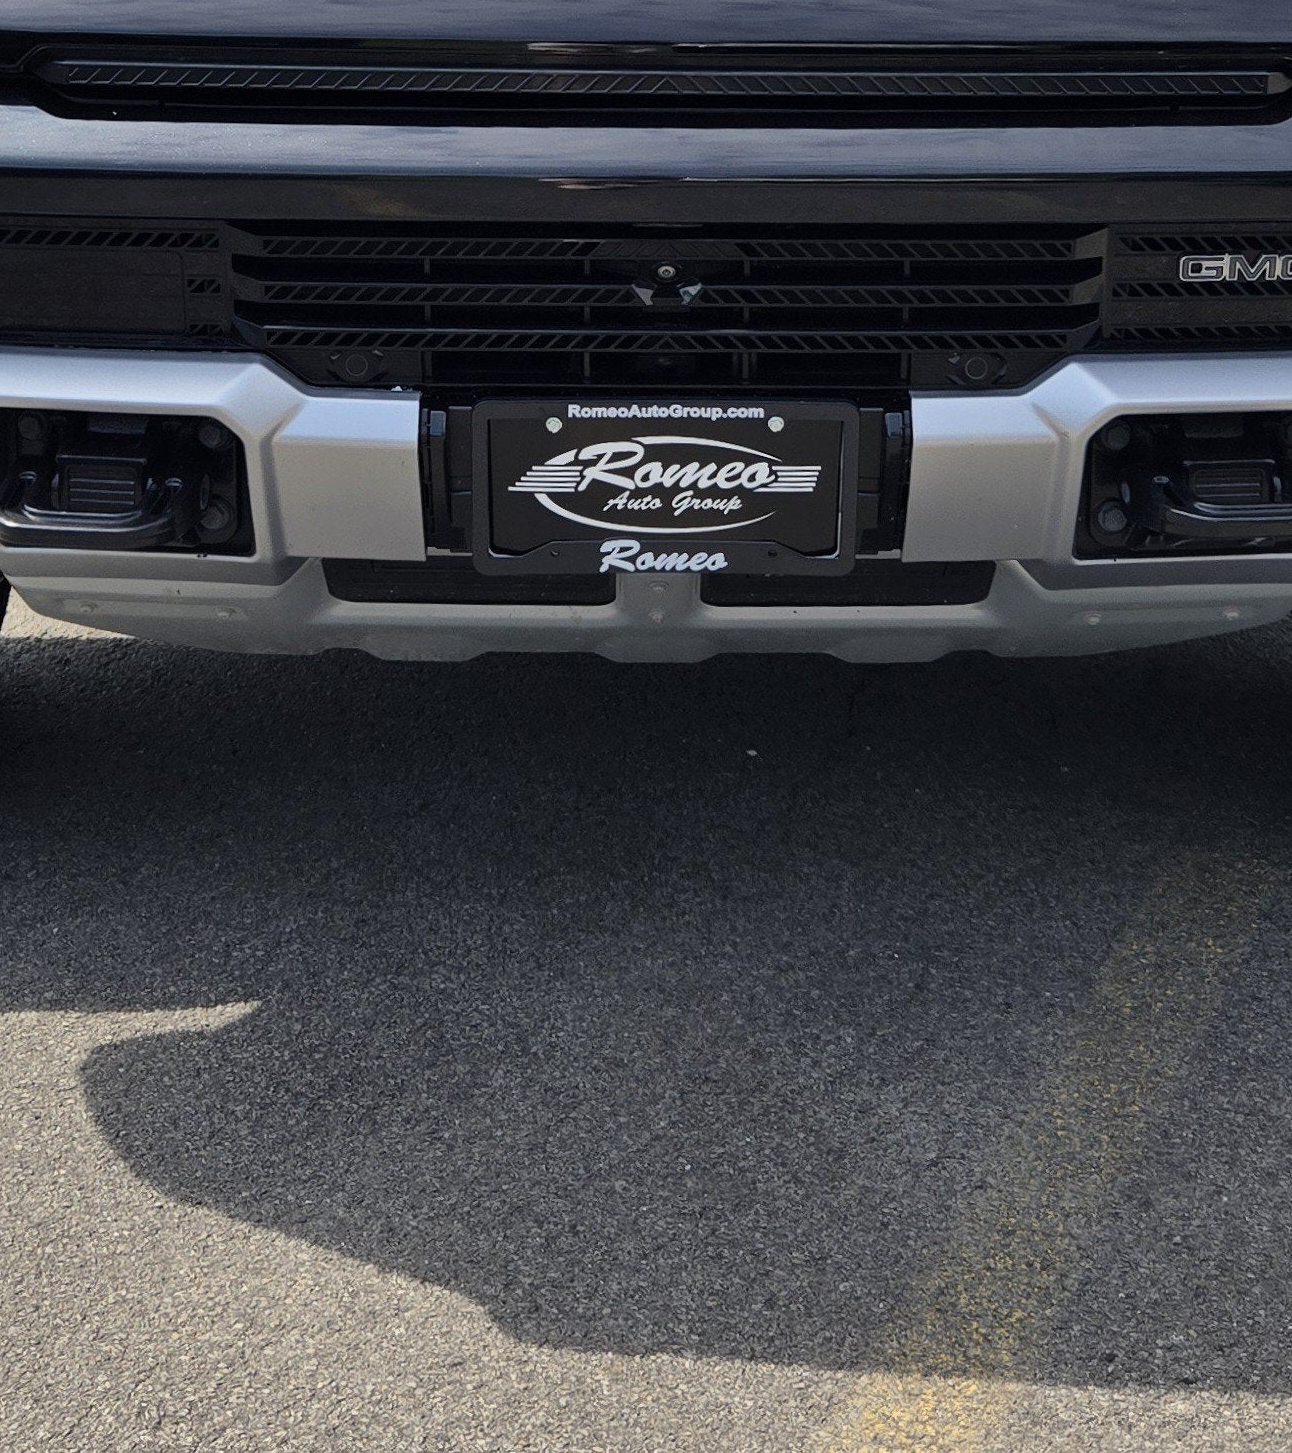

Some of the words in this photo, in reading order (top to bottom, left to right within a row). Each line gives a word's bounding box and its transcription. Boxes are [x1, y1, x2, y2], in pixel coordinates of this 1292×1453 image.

[567, 403, 765, 421] RomeoAutoGroup.com
[577, 440, 777, 493] Romeo
[603, 491, 663, 513] Auto
[671, 490, 743, 517] Group
[599, 539, 729, 573] Romeo
